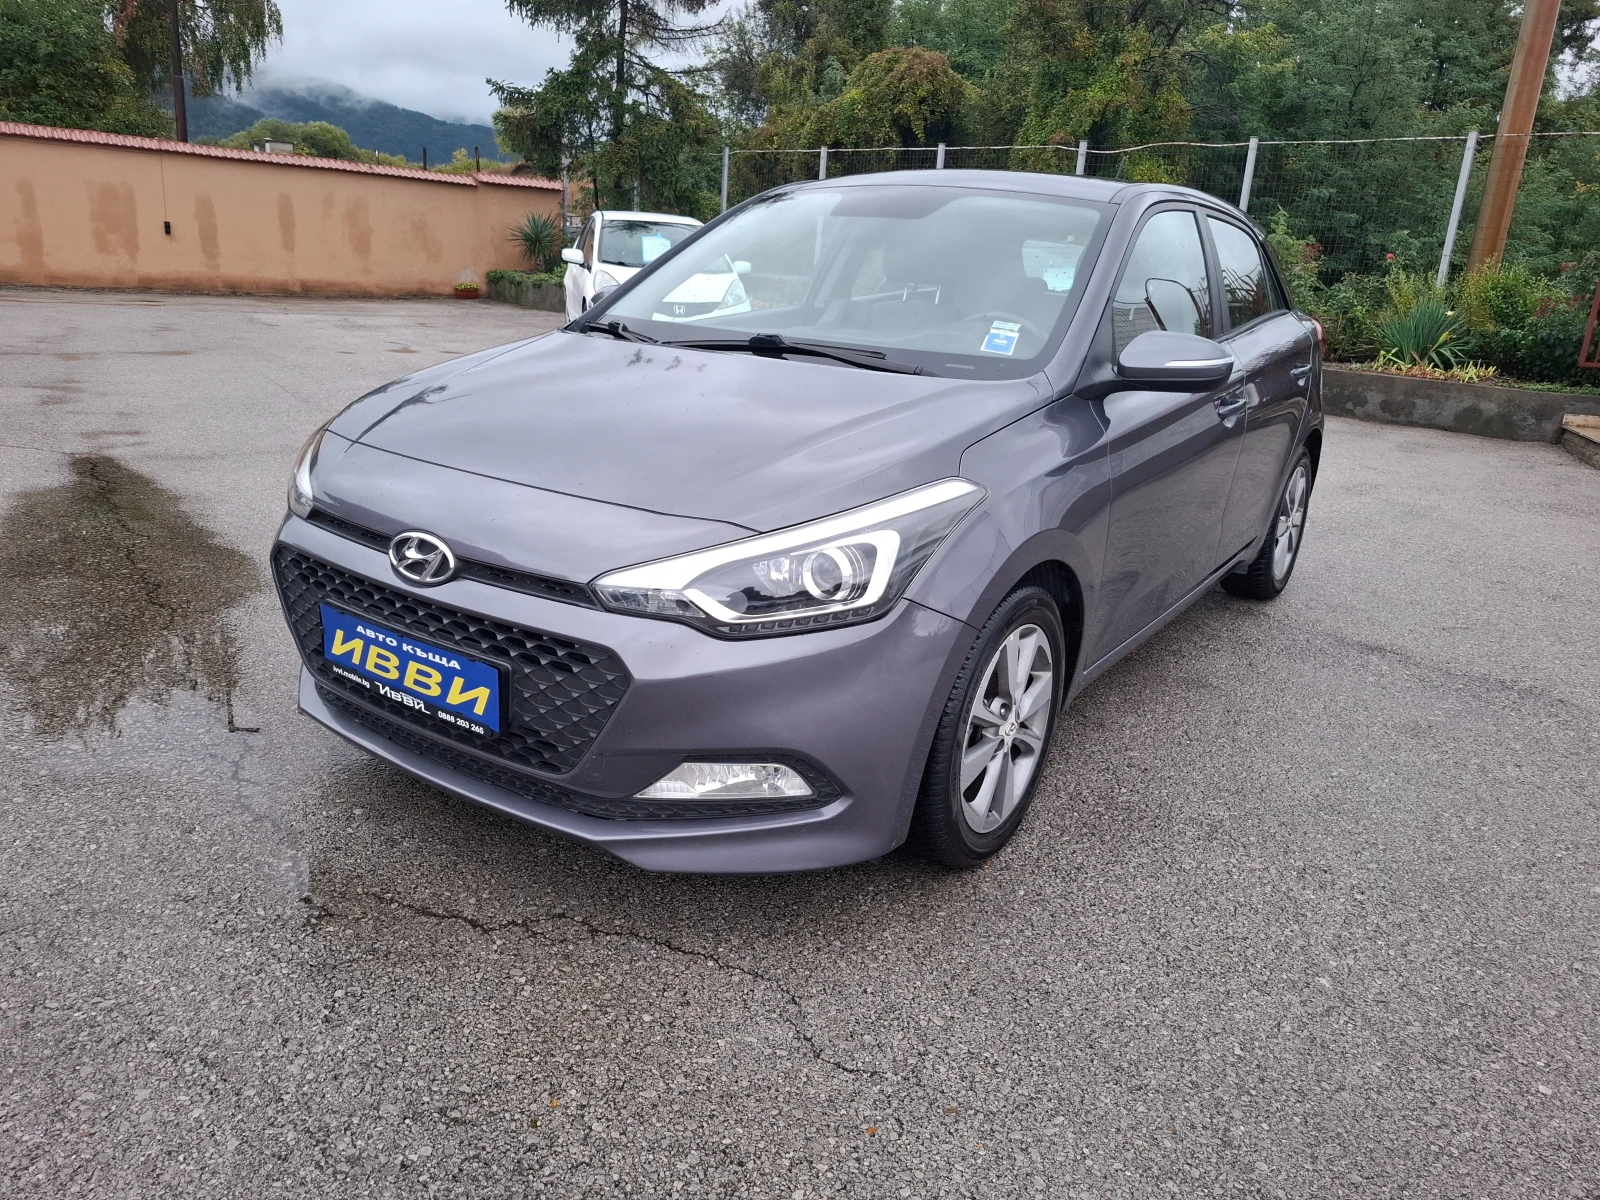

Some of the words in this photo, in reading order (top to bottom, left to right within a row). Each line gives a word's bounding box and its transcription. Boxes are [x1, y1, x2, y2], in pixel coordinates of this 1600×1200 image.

[356, 625, 398, 647] АВТО
[402, 642, 462, 670] КЪЩА
[331, 628, 491, 716] ИВВИ
[437, 710, 455, 723] 0888
[456, 717, 470, 729] 203
[470, 723, 485, 735] 265
